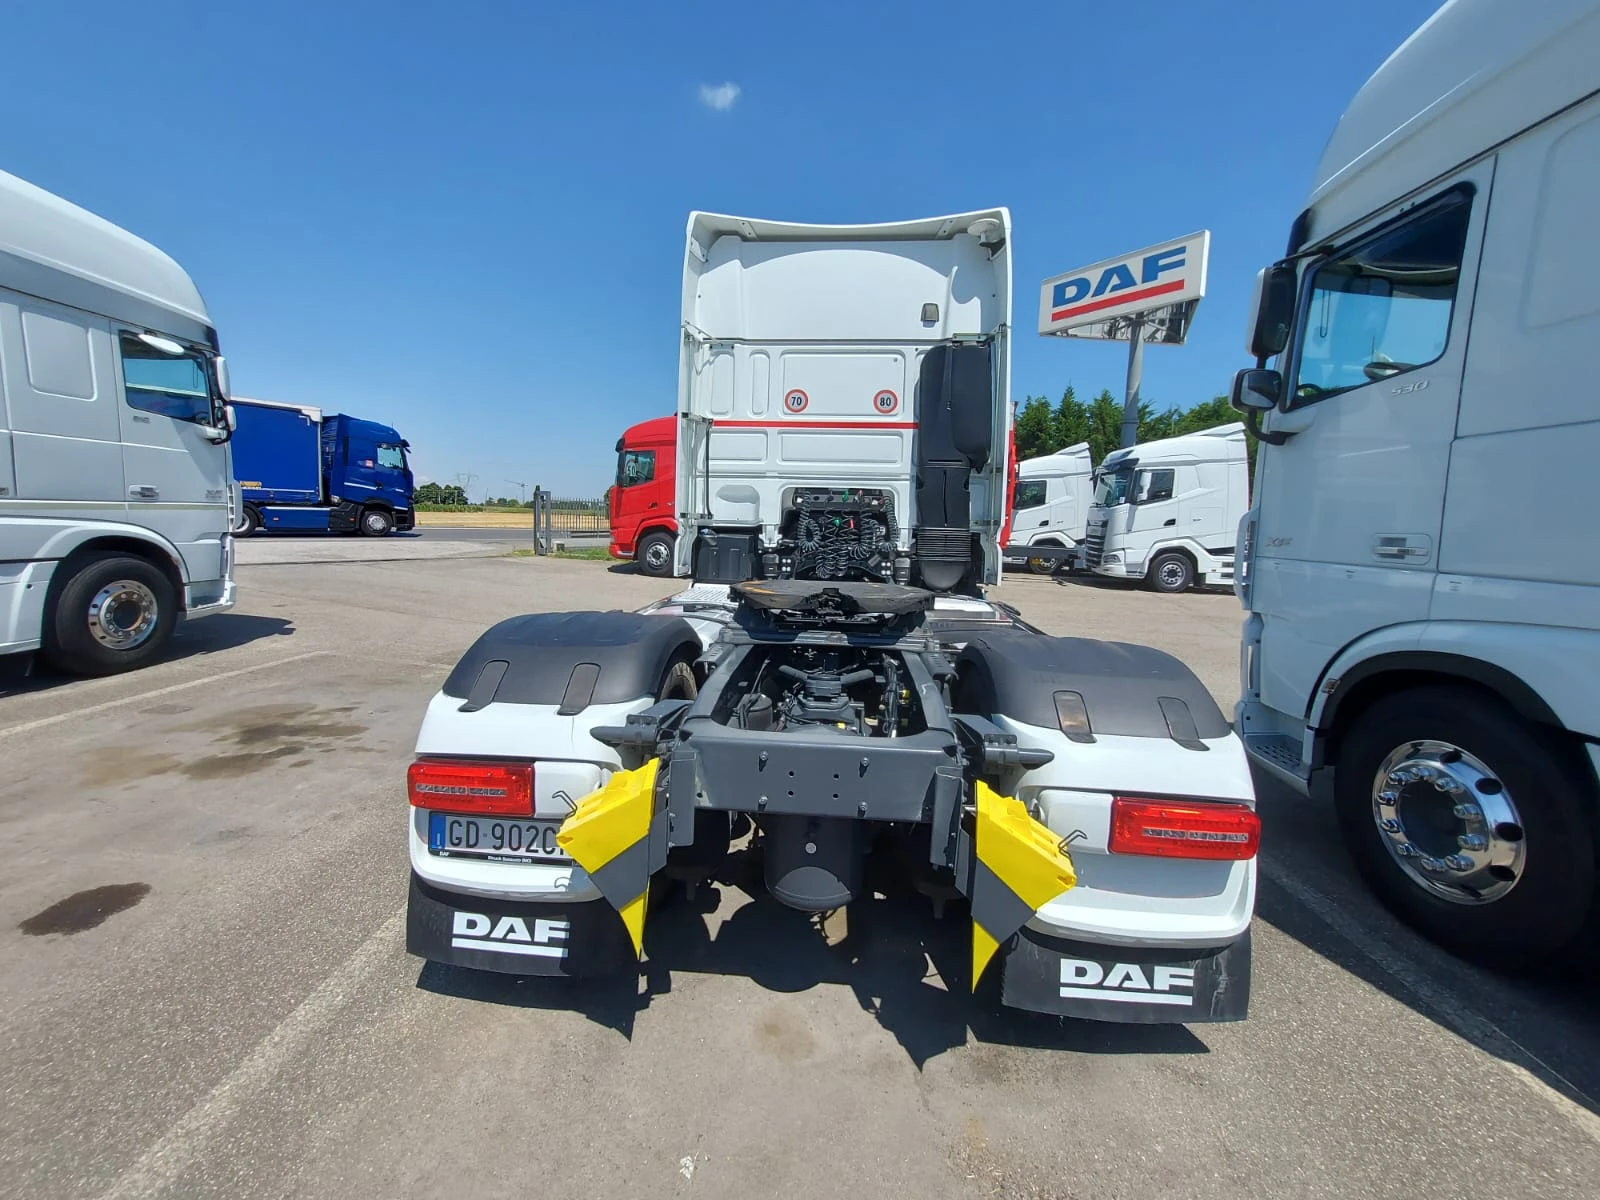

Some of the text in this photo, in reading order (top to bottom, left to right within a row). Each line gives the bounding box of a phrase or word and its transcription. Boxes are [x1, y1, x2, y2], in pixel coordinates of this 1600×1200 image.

[1052, 246, 1187, 308] DAF
[791, 396, 802, 406] 70
[880, 397, 891, 407] 80
[449, 820, 564, 855] GD 902C
[453, 911, 570, 943] DAF
[1060, 958, 1195, 991] DAF
